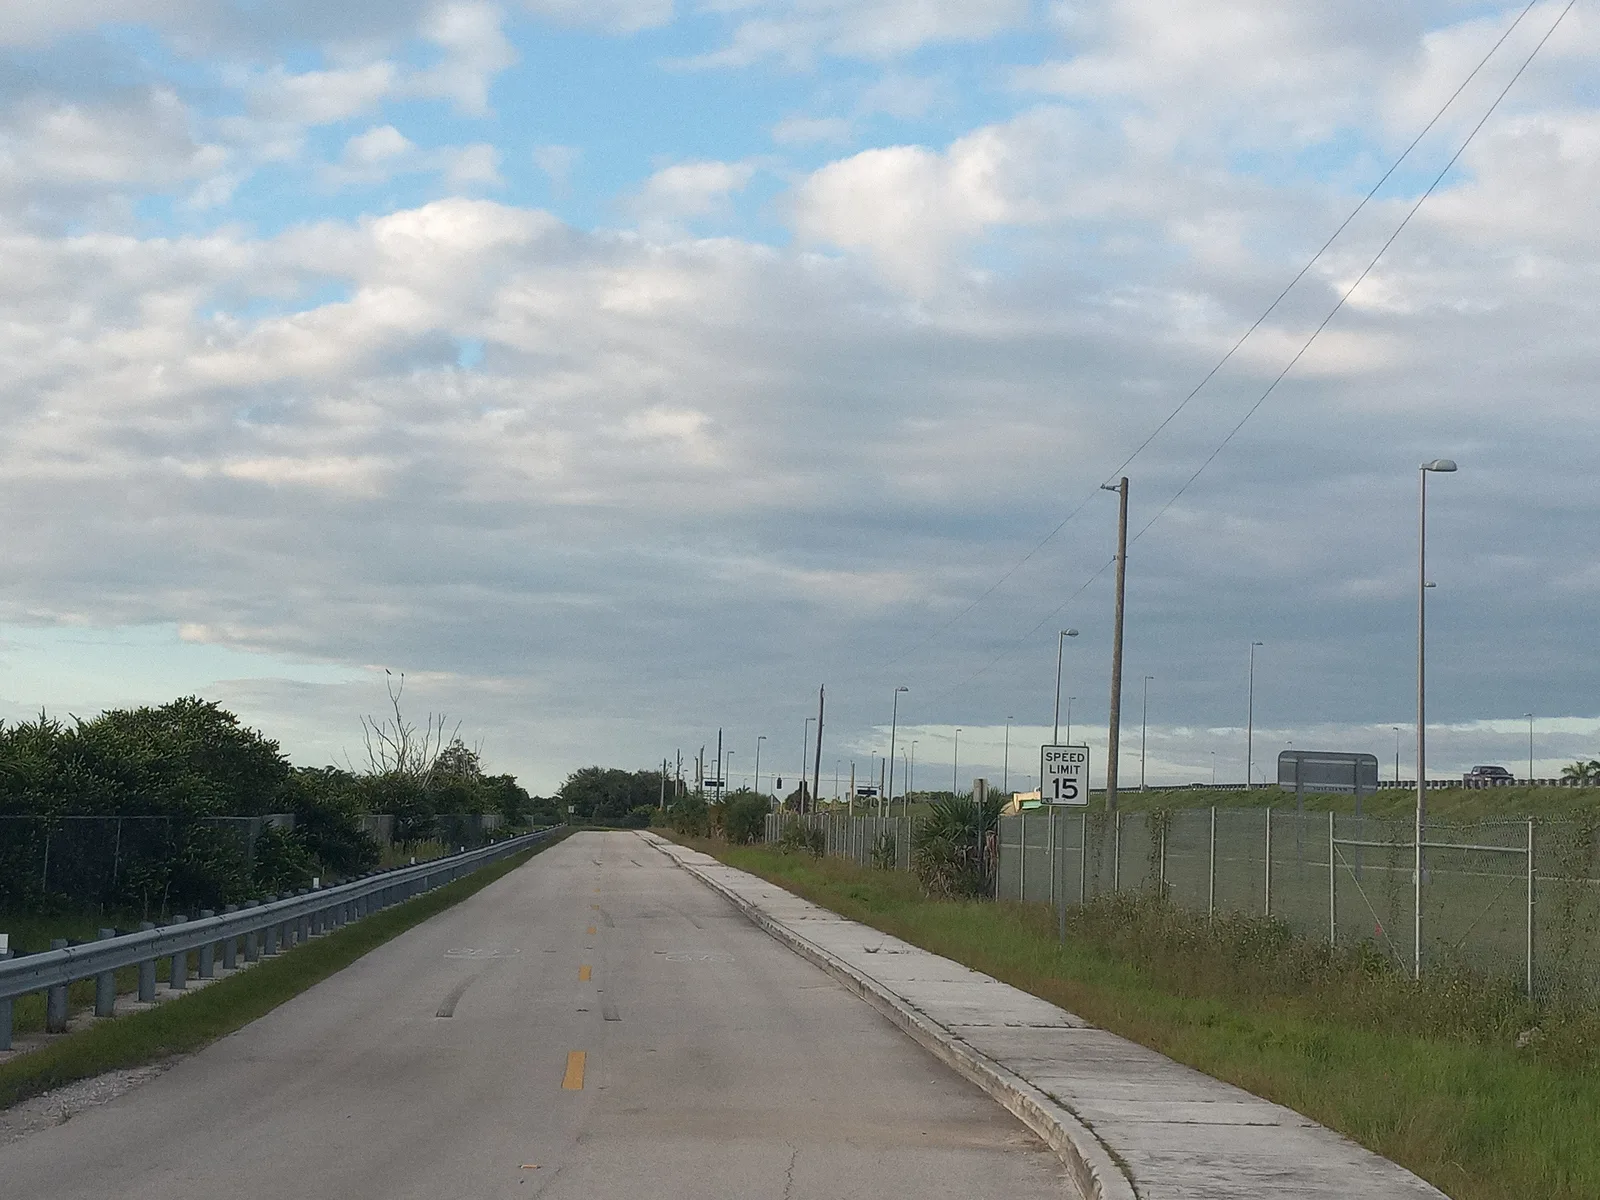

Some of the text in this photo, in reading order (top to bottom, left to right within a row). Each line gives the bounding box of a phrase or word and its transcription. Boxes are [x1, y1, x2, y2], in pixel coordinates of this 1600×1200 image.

[1045, 752, 1085, 763] SPEED
[1049, 764, 1081, 775] LIMIT
[1052, 778, 1079, 799] 15
